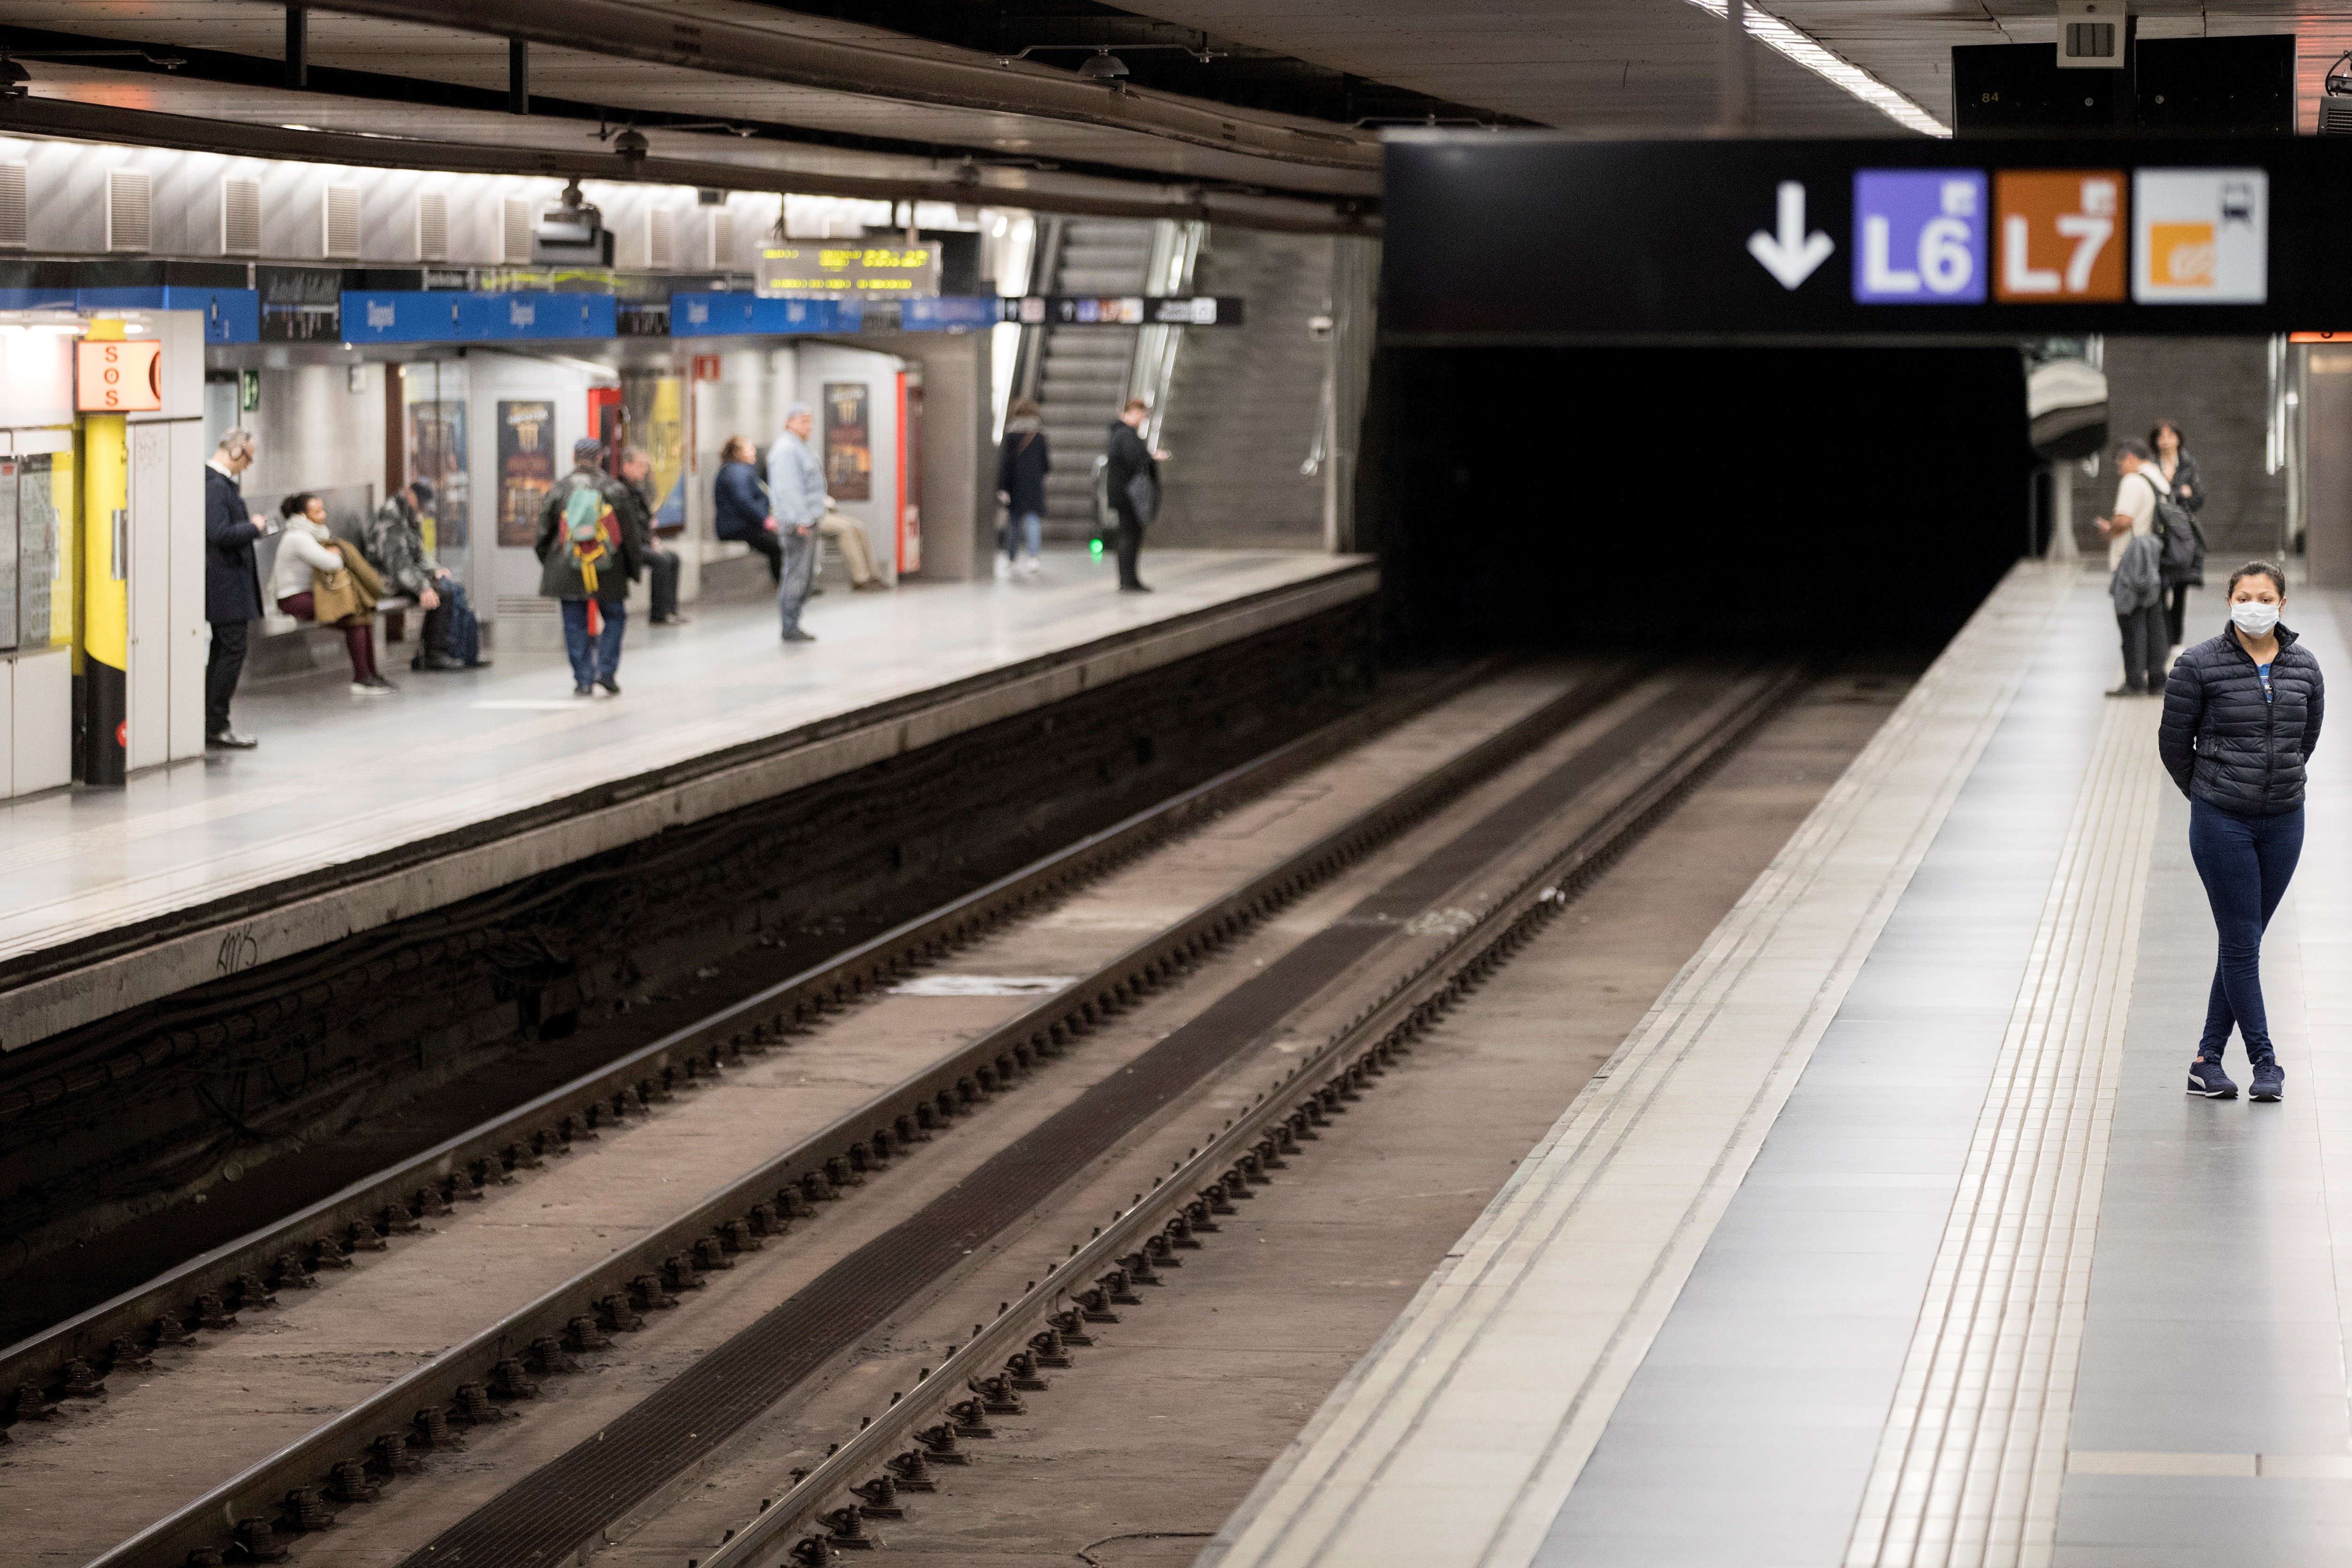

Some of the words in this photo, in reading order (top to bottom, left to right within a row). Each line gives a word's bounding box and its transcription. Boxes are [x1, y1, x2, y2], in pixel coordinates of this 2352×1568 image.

[1982, 92, 1999, 103] 84
[1862, 214, 1974, 295] L6
[2003, 213, 2114, 294] L7
[104, 346, 119, 406] SOS
